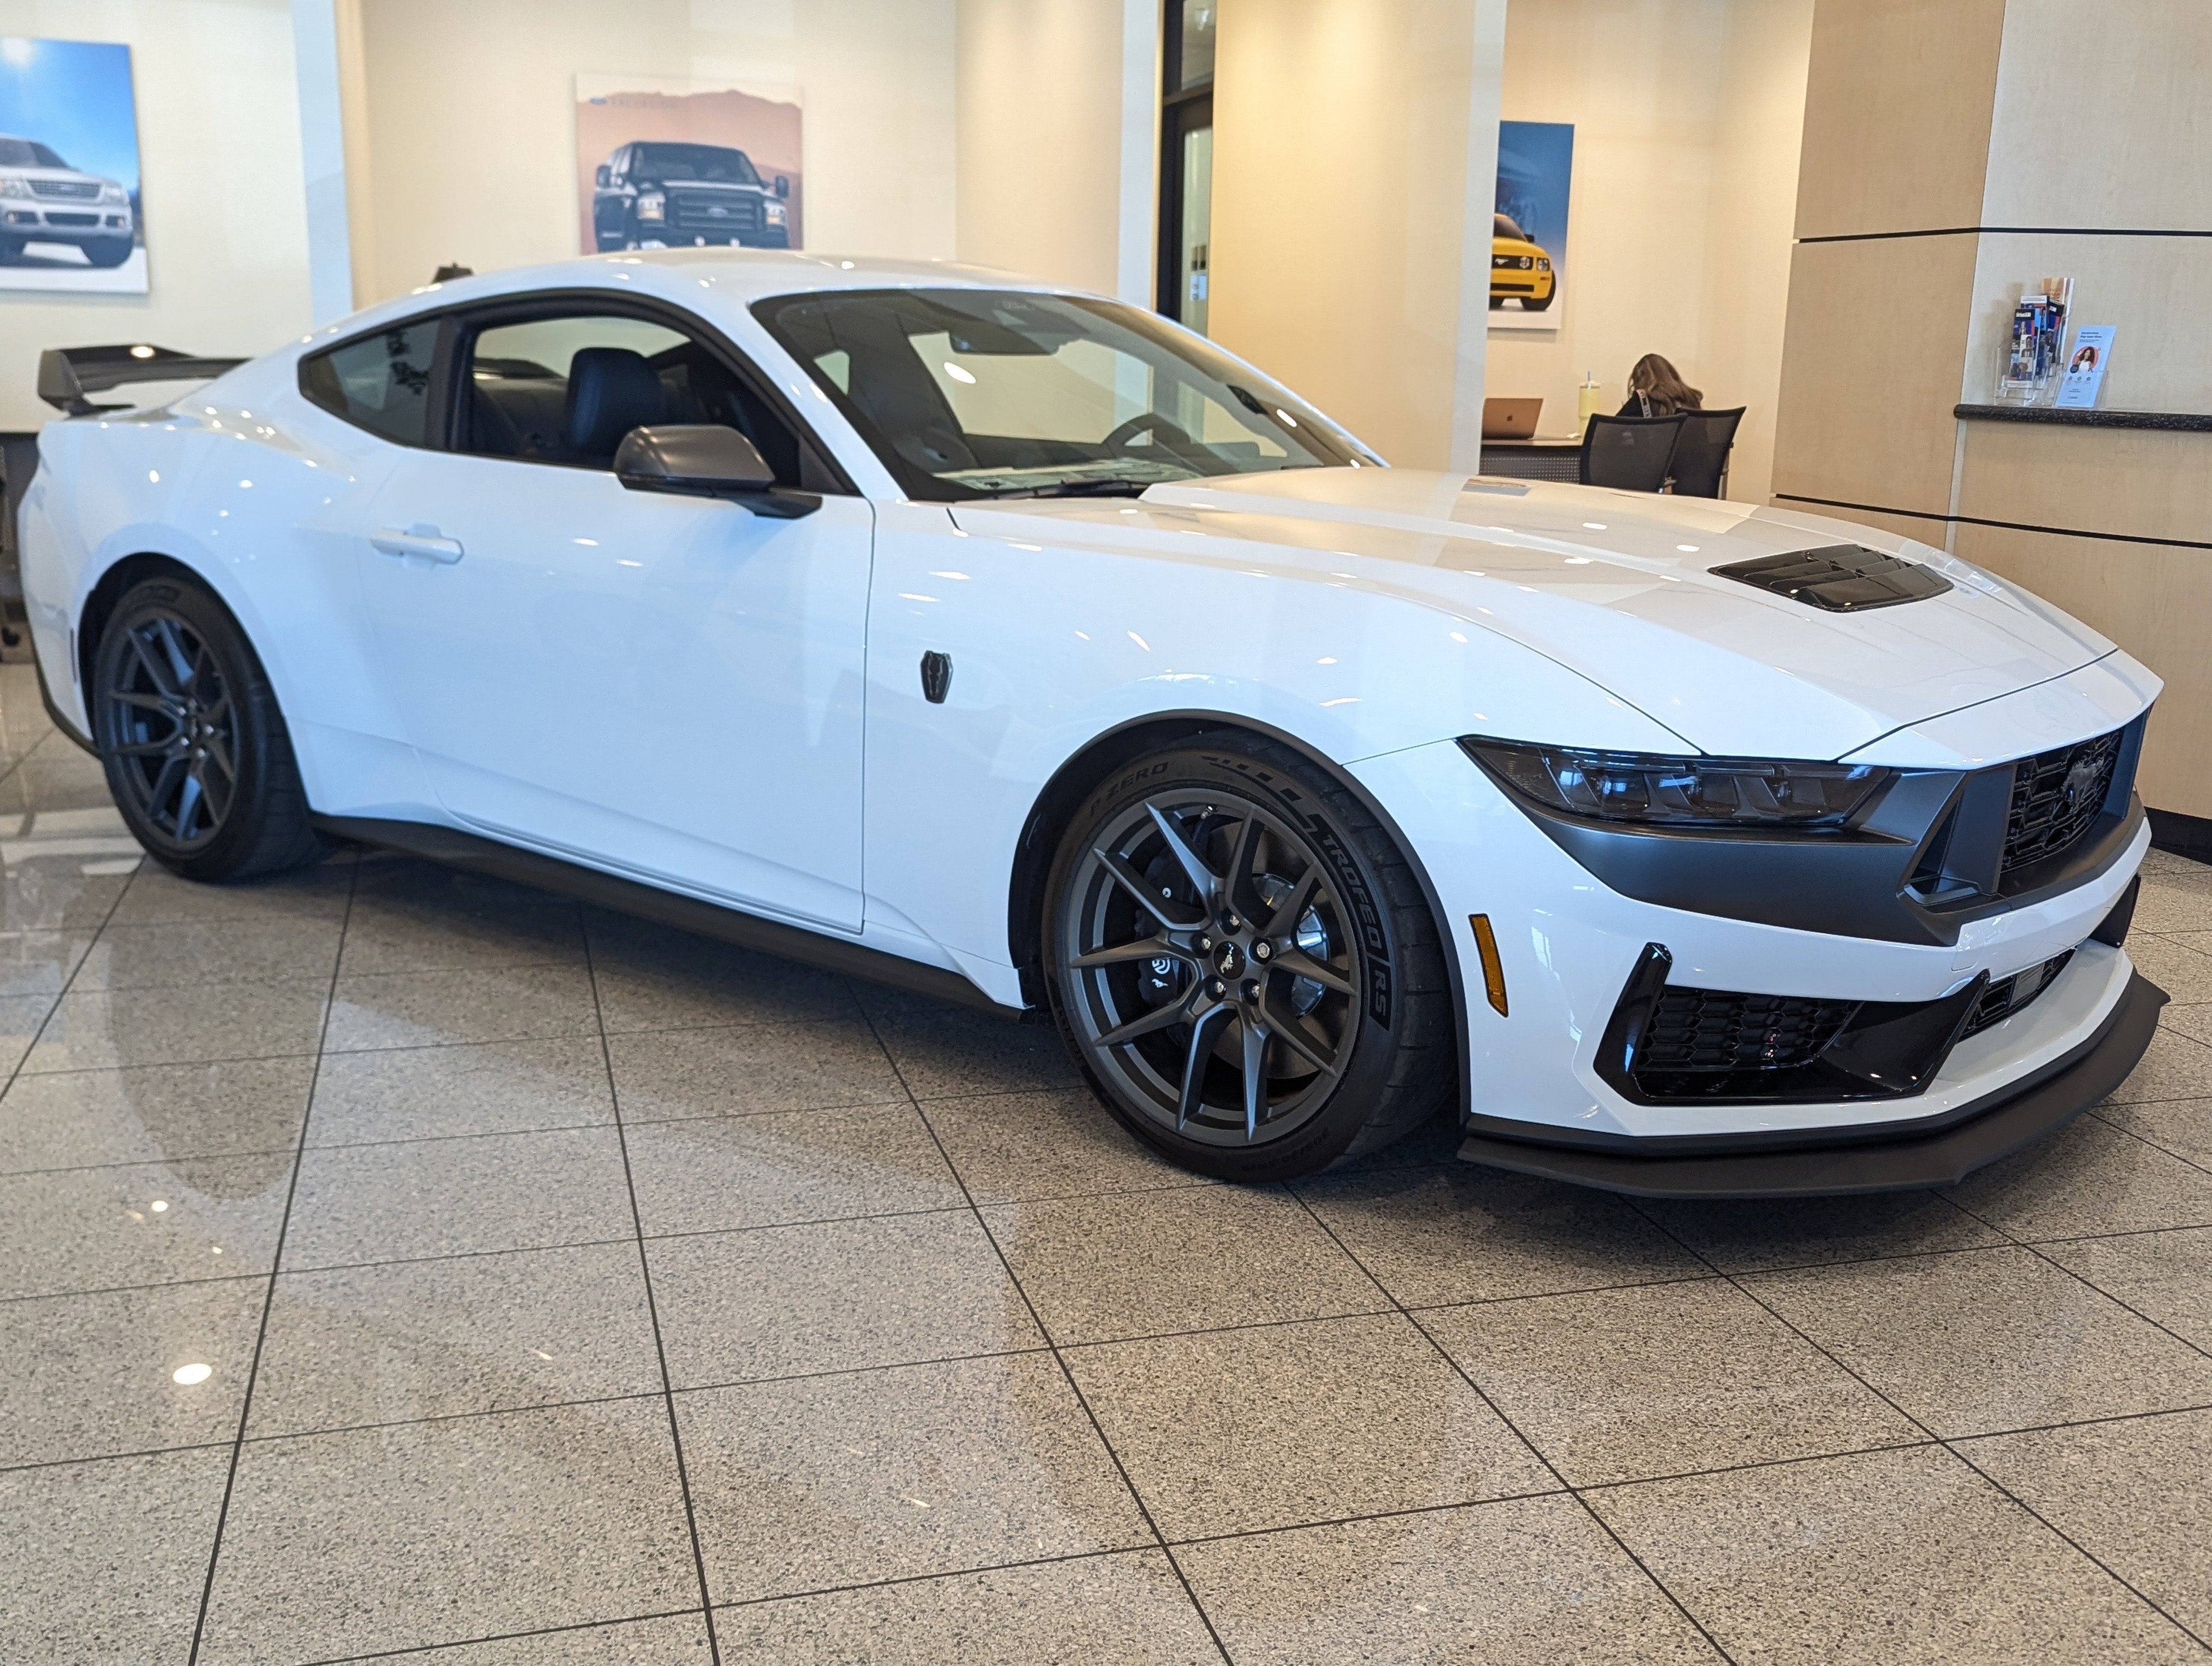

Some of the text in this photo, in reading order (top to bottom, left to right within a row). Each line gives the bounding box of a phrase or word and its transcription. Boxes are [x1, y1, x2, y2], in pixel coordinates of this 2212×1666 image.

[1106, 761, 1168, 800] ZERO
[1323, 834, 1386, 1017] TROFEO RS
